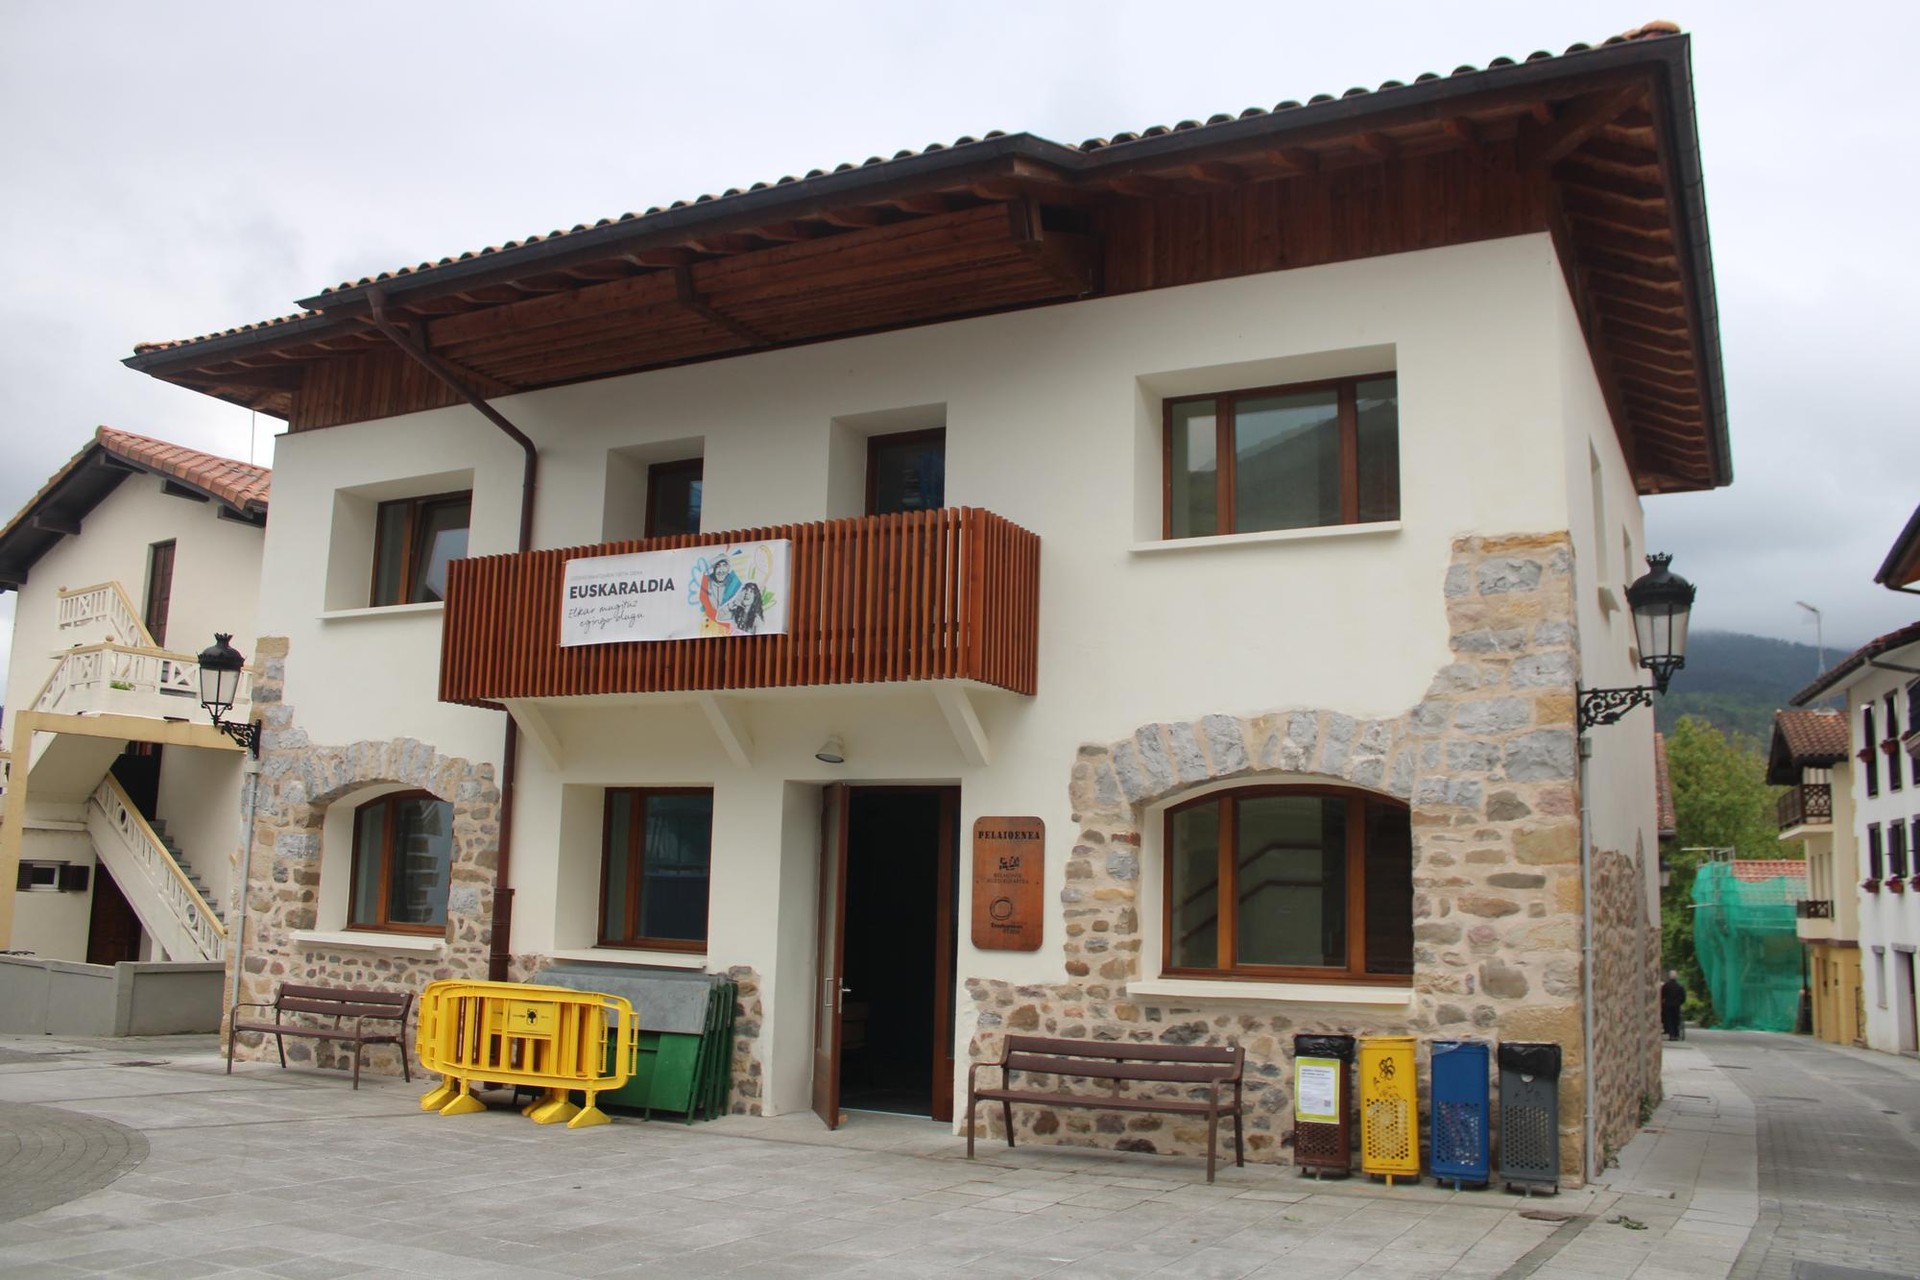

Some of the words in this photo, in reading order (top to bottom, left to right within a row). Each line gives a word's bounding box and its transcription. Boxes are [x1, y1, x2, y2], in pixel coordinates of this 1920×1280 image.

[569, 577, 675, 599] EUSKARALDIA
[568, 606, 596, 619] Elkar
[614, 610, 645, 628] dugu
[978, 830, 1041, 840] PELAIOENEA
